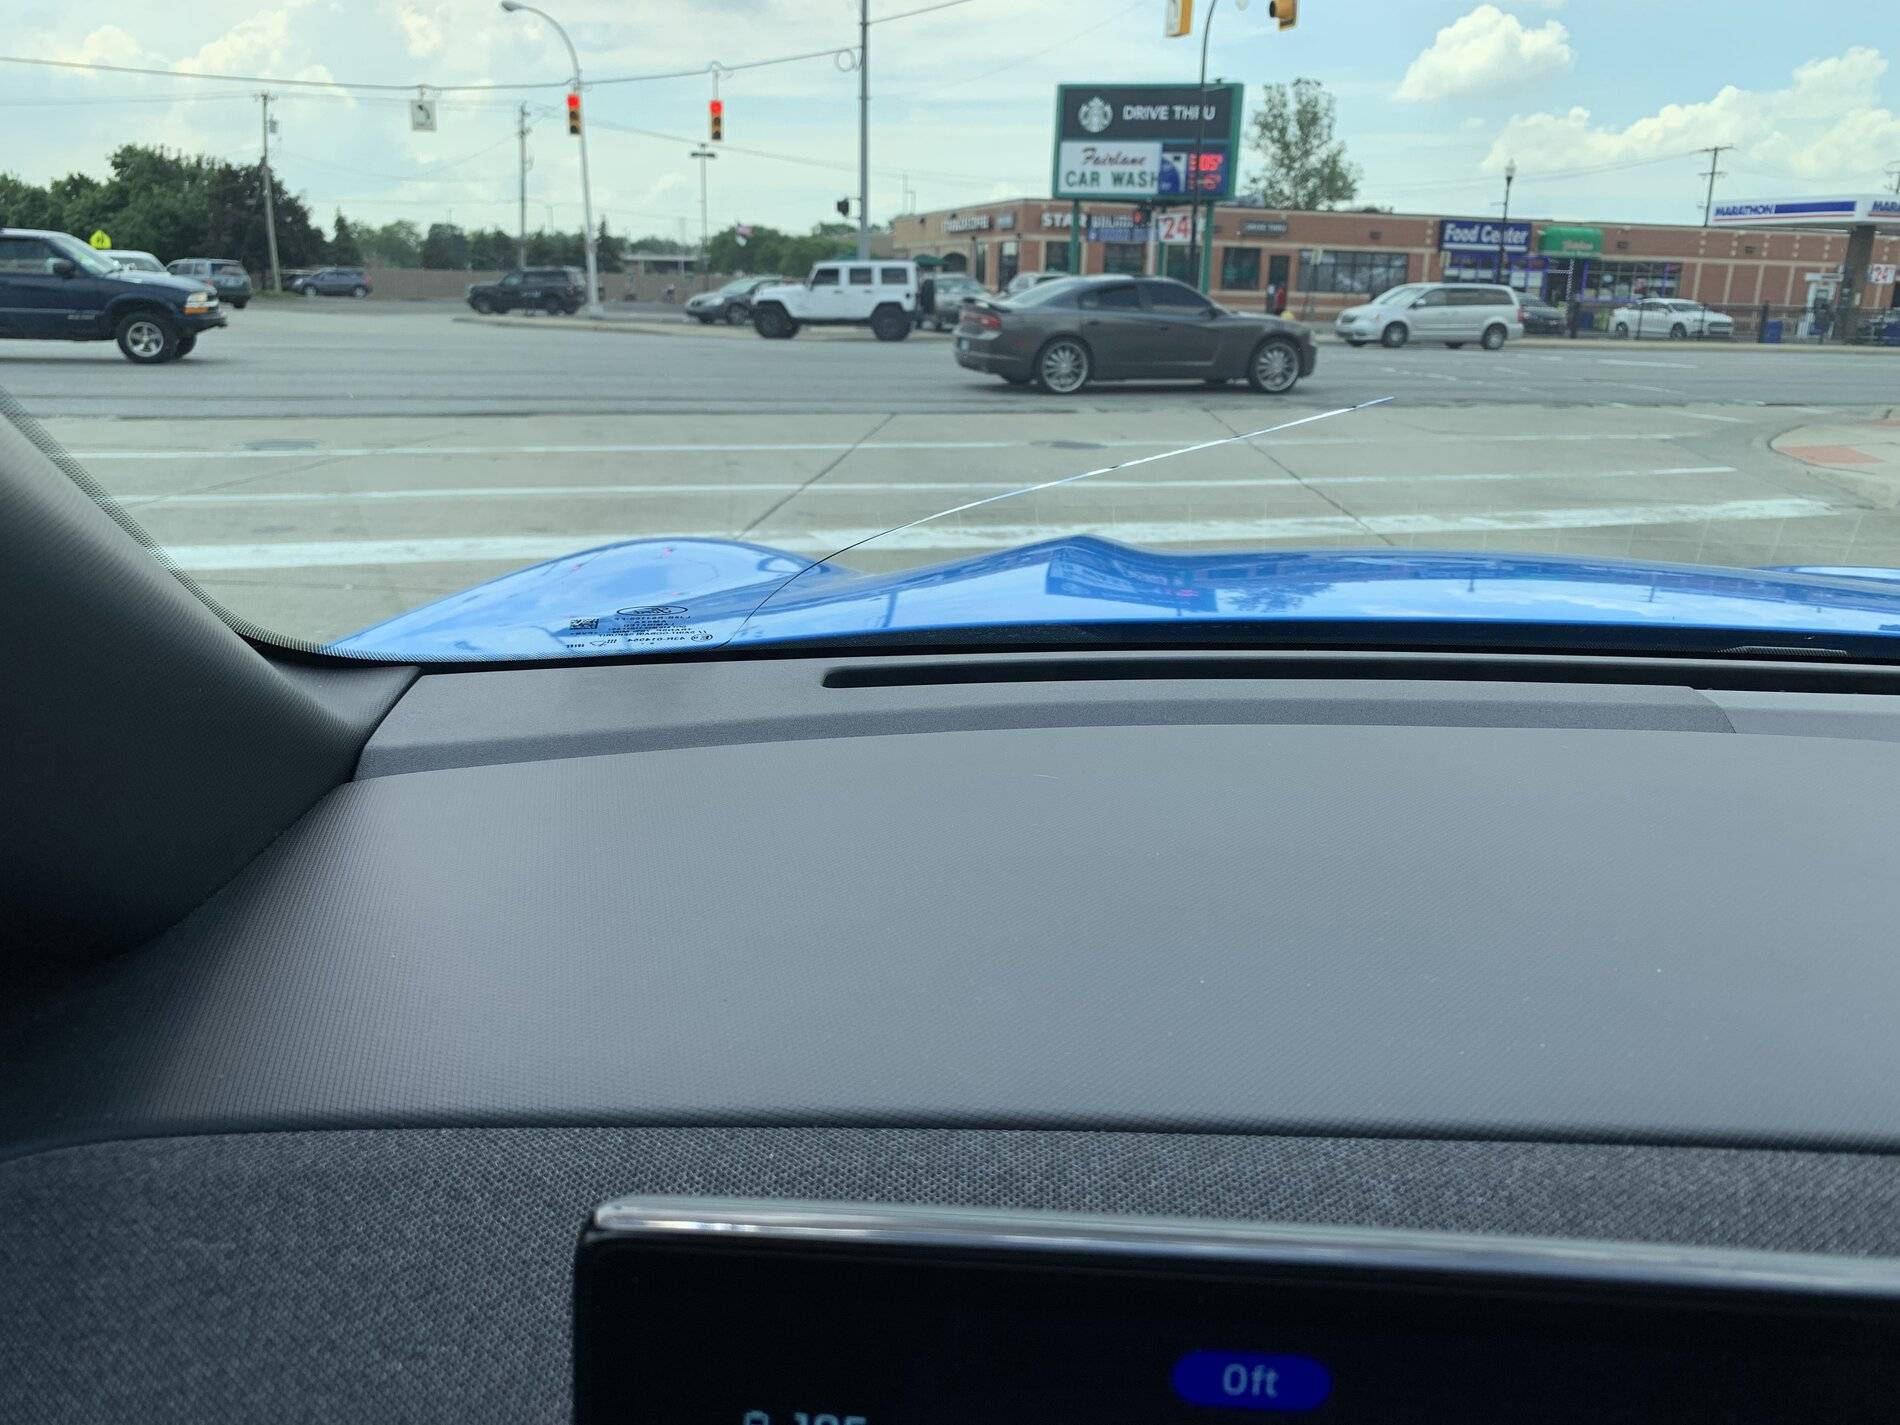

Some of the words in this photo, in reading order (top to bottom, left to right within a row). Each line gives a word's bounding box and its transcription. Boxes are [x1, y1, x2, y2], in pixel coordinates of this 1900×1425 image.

[1122, 104, 1170, 121] DRIVE
[1081, 147, 1147, 166] Fairlane
[1065, 170, 1101, 188] CAR
[1714, 203, 1774, 217] MARATHON
[1161, 215, 1189, 240] 24
[1443, 222, 1481, 243] Food
[1480, 224, 1529, 244] Center
[1222, 1363, 1280, 1398] 0ft
